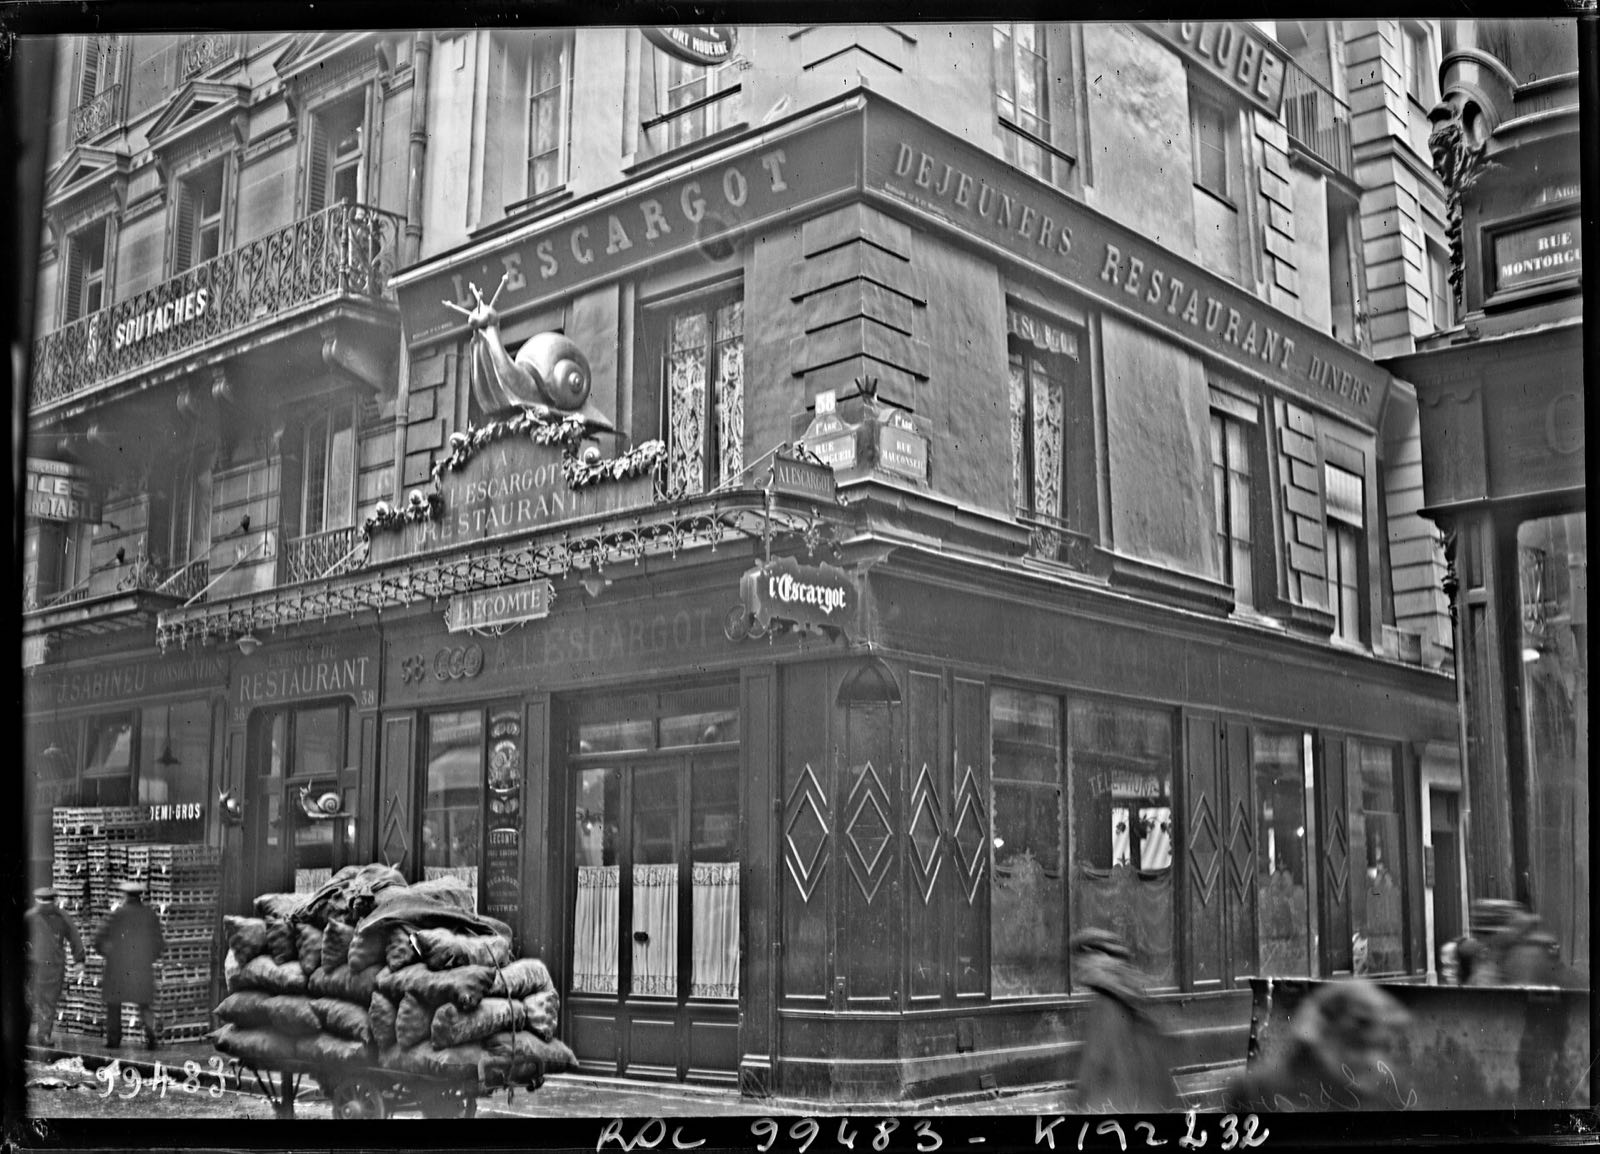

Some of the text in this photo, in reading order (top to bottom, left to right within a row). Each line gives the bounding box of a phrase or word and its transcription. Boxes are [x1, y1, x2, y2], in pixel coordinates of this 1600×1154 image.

[692, 36, 729, 56] MODERNE
[1538, 232, 1572, 252] RUE
[896, 143, 1371, 406] DEJEUNERS RESTAURANT DINERS
[115, 288, 207, 350] SOUTACHES
[815, 441, 835, 455] RUE
[881, 448, 924, 471] MAUCONSEIL
[896, 440, 912, 455] RUE
[424, 490, 579, 541] RESTAURANT
[457, 588, 542, 623] LECOMTE
[769, 573, 846, 616] l'Escargot
[239, 656, 369, 702] RESTAURANT
[361, 689, 375, 706] 38
